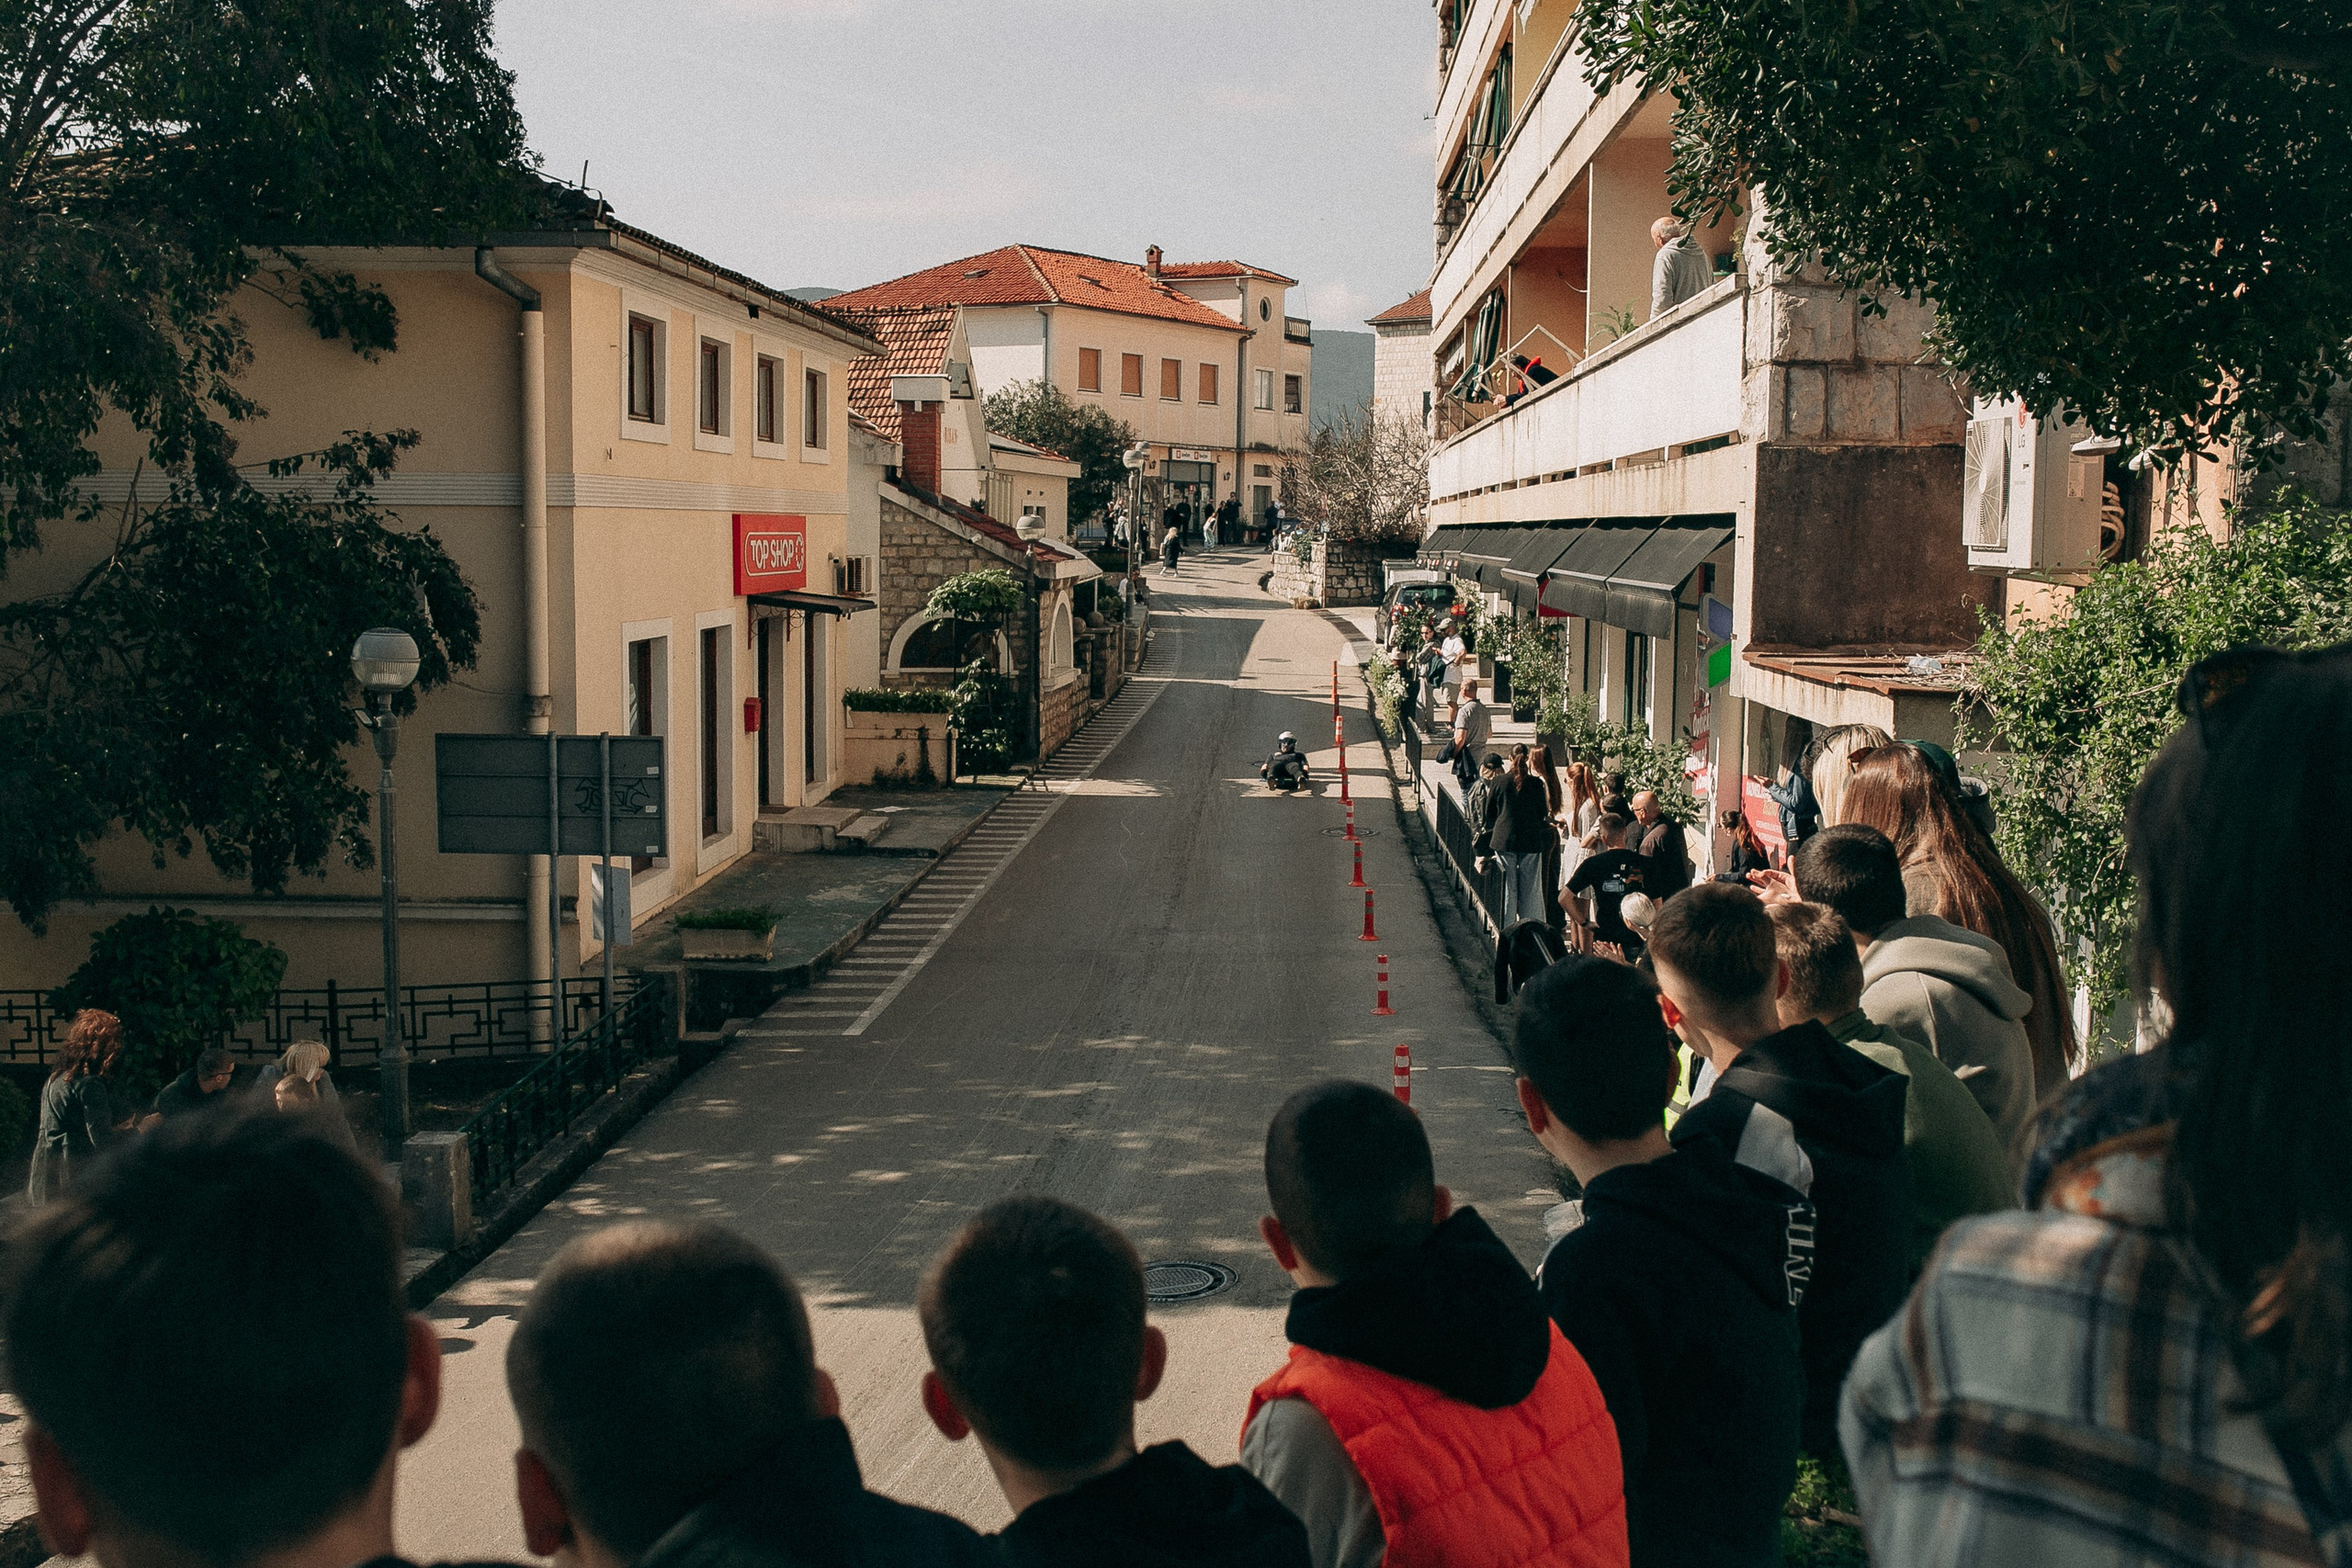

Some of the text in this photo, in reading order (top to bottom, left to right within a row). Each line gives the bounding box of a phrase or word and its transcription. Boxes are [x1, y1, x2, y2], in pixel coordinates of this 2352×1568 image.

[2018, 434, 2026, 448] LG
[750, 539, 794, 570] TOP SHOP
